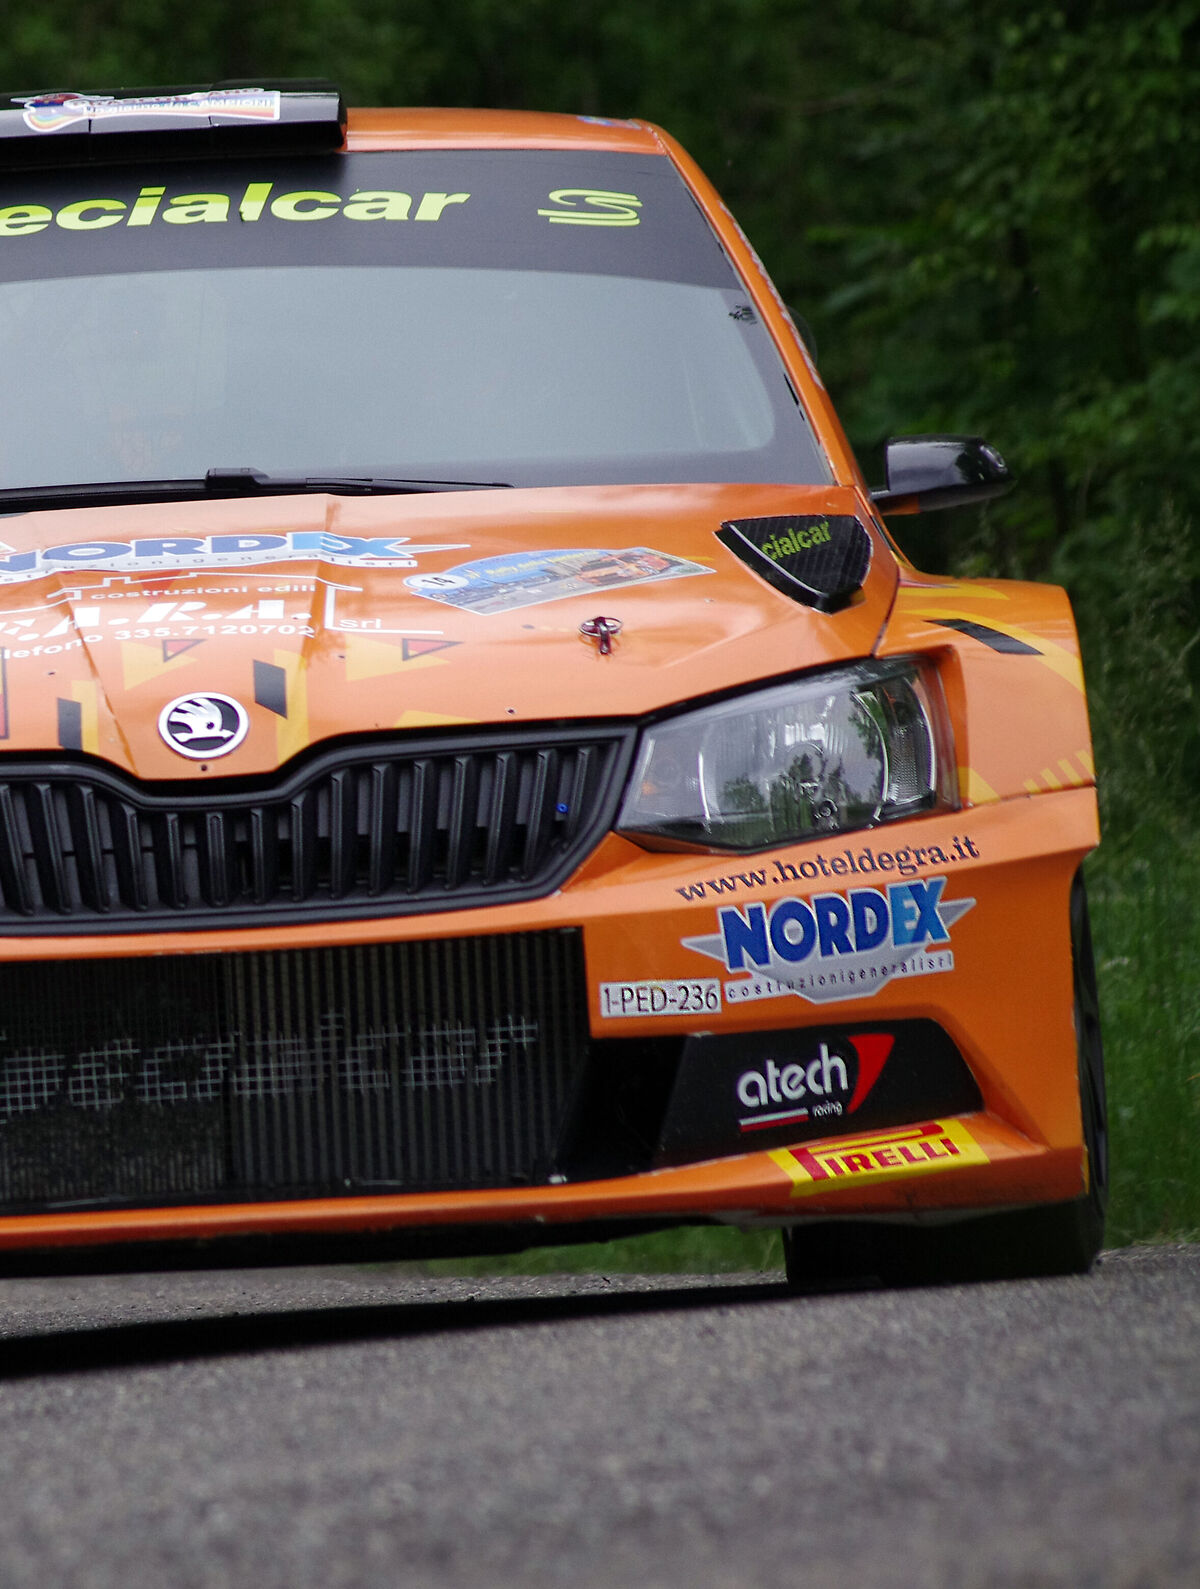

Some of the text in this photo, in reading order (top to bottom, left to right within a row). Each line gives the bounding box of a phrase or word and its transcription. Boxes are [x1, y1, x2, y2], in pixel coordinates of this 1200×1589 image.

[761, 520, 832, 561] cialcar
[90, 584, 316, 600] costruzioni edili
[114, 624, 316, 641] 335.7120702
[674, 835, 981, 902] www.hoteldegra.it
[718, 875, 951, 972] NORDEX
[737, 1042, 849, 1107] atech
[788, 1123, 962, 1182] PIRELLI
